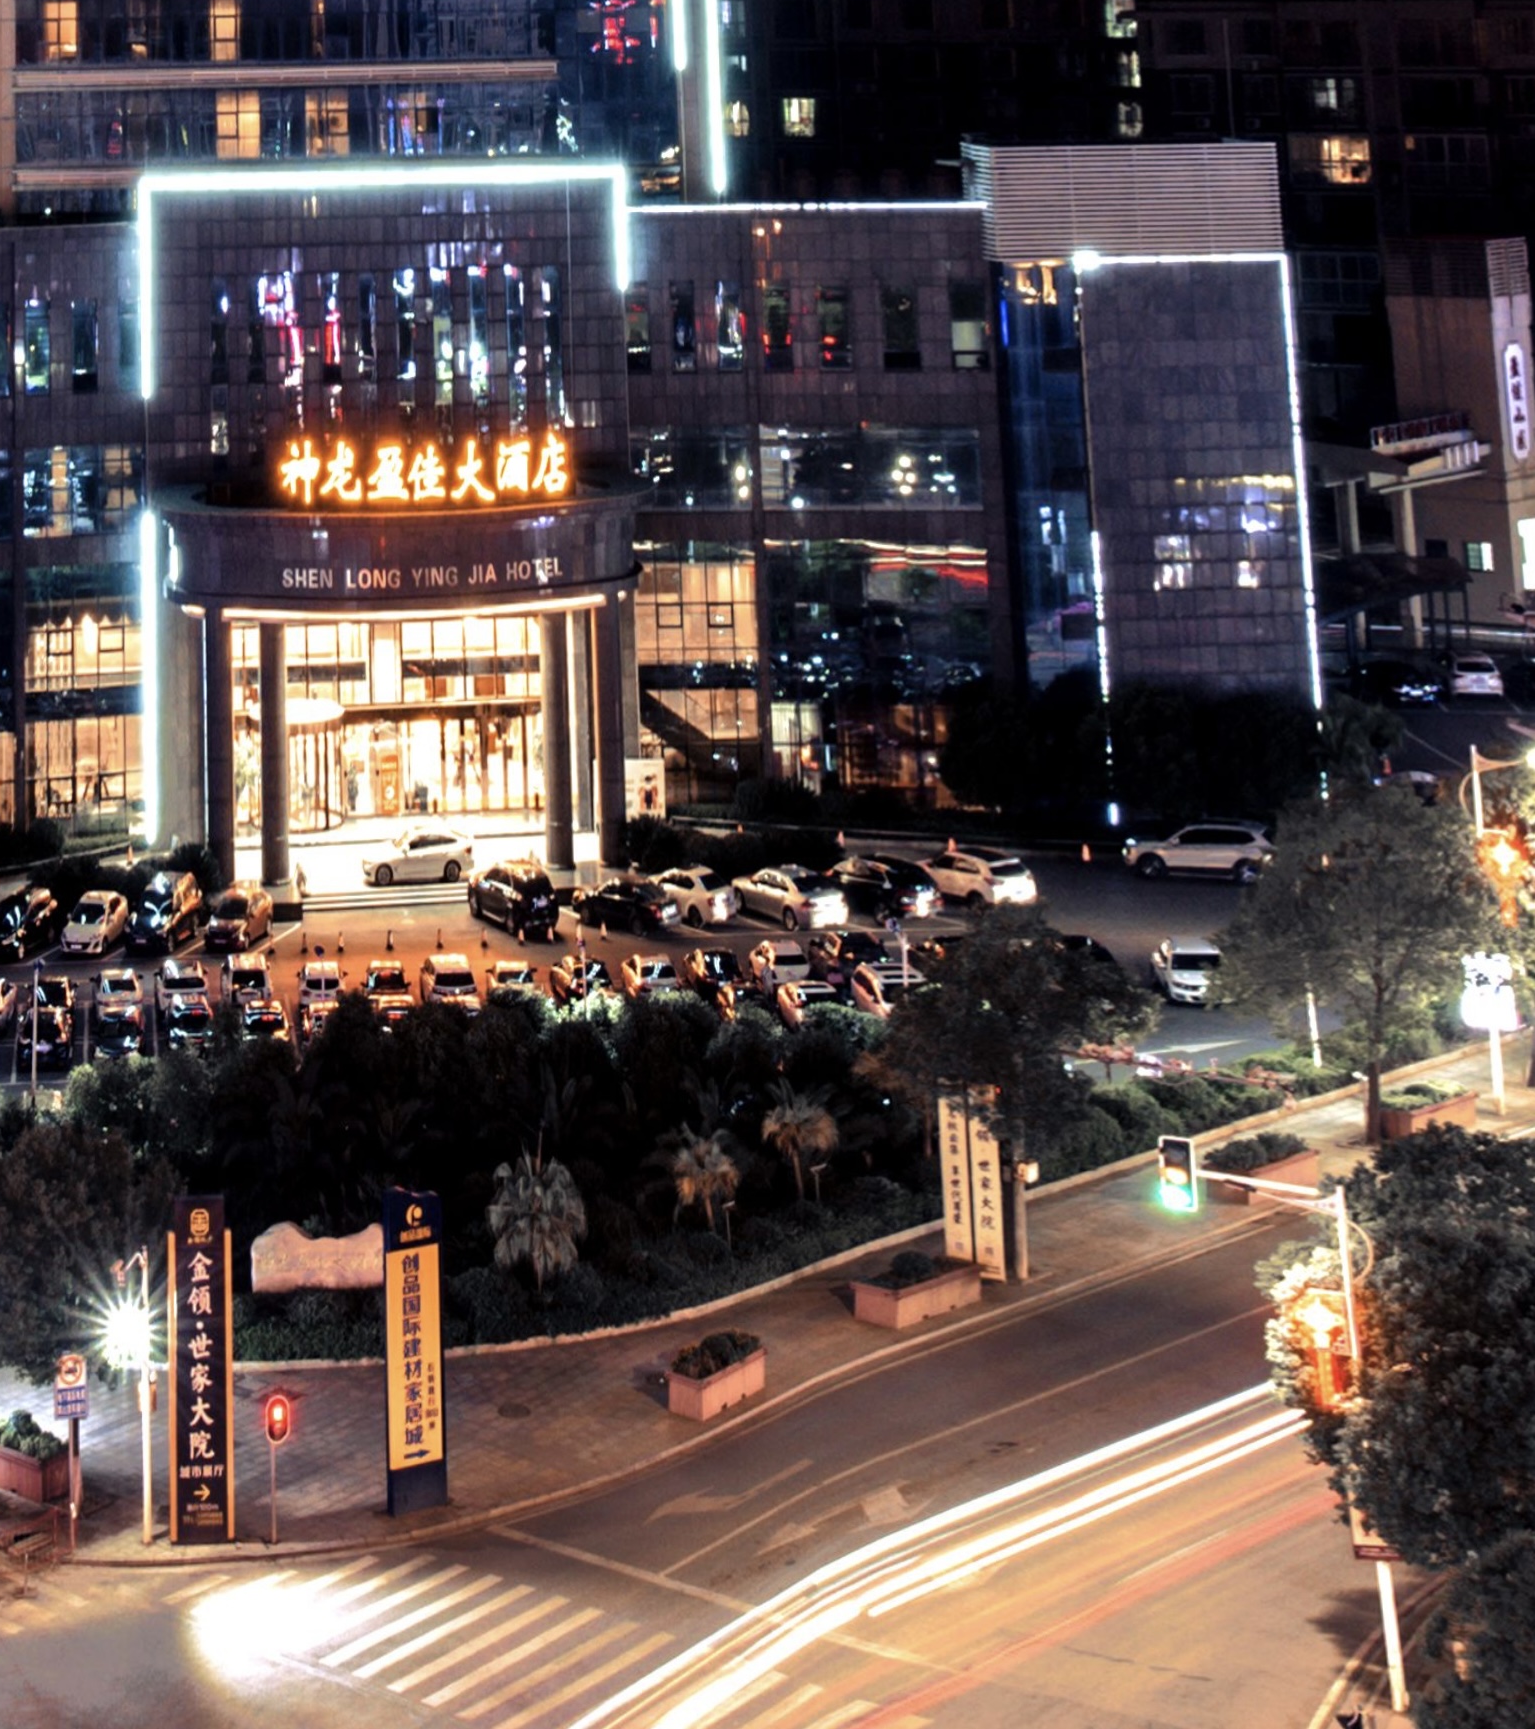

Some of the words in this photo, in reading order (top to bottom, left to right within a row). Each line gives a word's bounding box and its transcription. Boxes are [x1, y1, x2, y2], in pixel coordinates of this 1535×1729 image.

[280, 431, 568, 504] 神龙盈佳大酒店
[281, 567, 333, 590] SHEN
[345, 567, 401, 590] LONG
[411, 566, 459, 588] YING
[468, 562, 497, 585] JIA
[505, 557, 563, 582] HOTEL
[402, 1252, 424, 1446] 创品国际建材家居城
